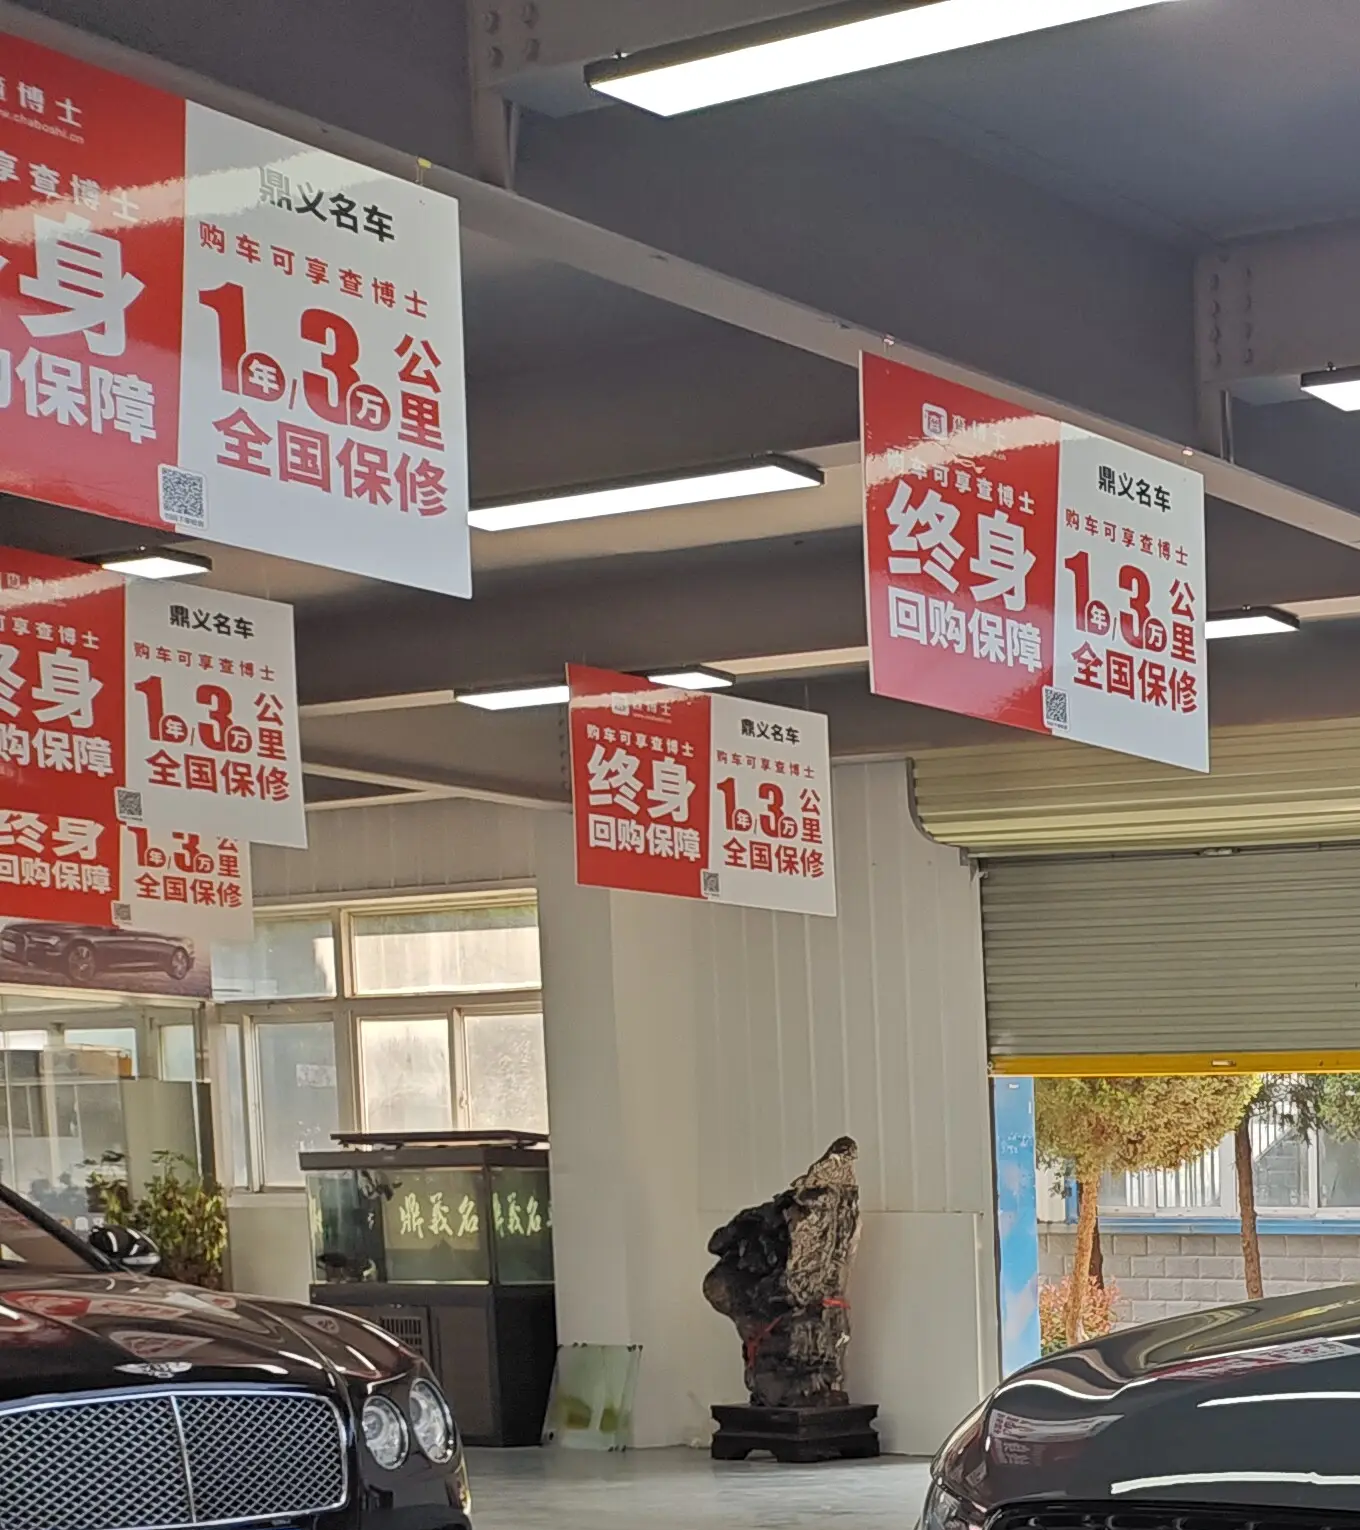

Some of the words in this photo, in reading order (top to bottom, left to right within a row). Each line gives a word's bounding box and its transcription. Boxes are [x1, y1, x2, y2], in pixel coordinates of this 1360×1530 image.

[259, 165, 396, 242] 鼎义名车
[0, 212, 146, 357] 身
[199, 221, 429, 319] 购车可享查博士
[213, 407, 449, 518] 全国保修
[1098, 465, 1171, 513] 鼎义名车
[886, 483, 1036, 611] 终身
[1065, 508, 1189, 567] 购车可享查博士
[169, 604, 255, 639] 鼎义名车
[888, 585, 1044, 673] 回购保障
[134, 641, 276, 682] 购车可享查博士
[1072, 641, 1198, 714] 全国保修
[586, 723, 695, 757] 购车可享查博士
[740, 718, 800, 745] 鼎义名车
[145, 749, 291, 802] 全国保修
[587, 743, 696, 823] 终身
[716, 750, 815, 780] 购车可享查博士
[588, 812, 702, 863] 回购保障
[723, 837, 825, 879] 全国保修
[135, 872, 243, 908] 全国保修
